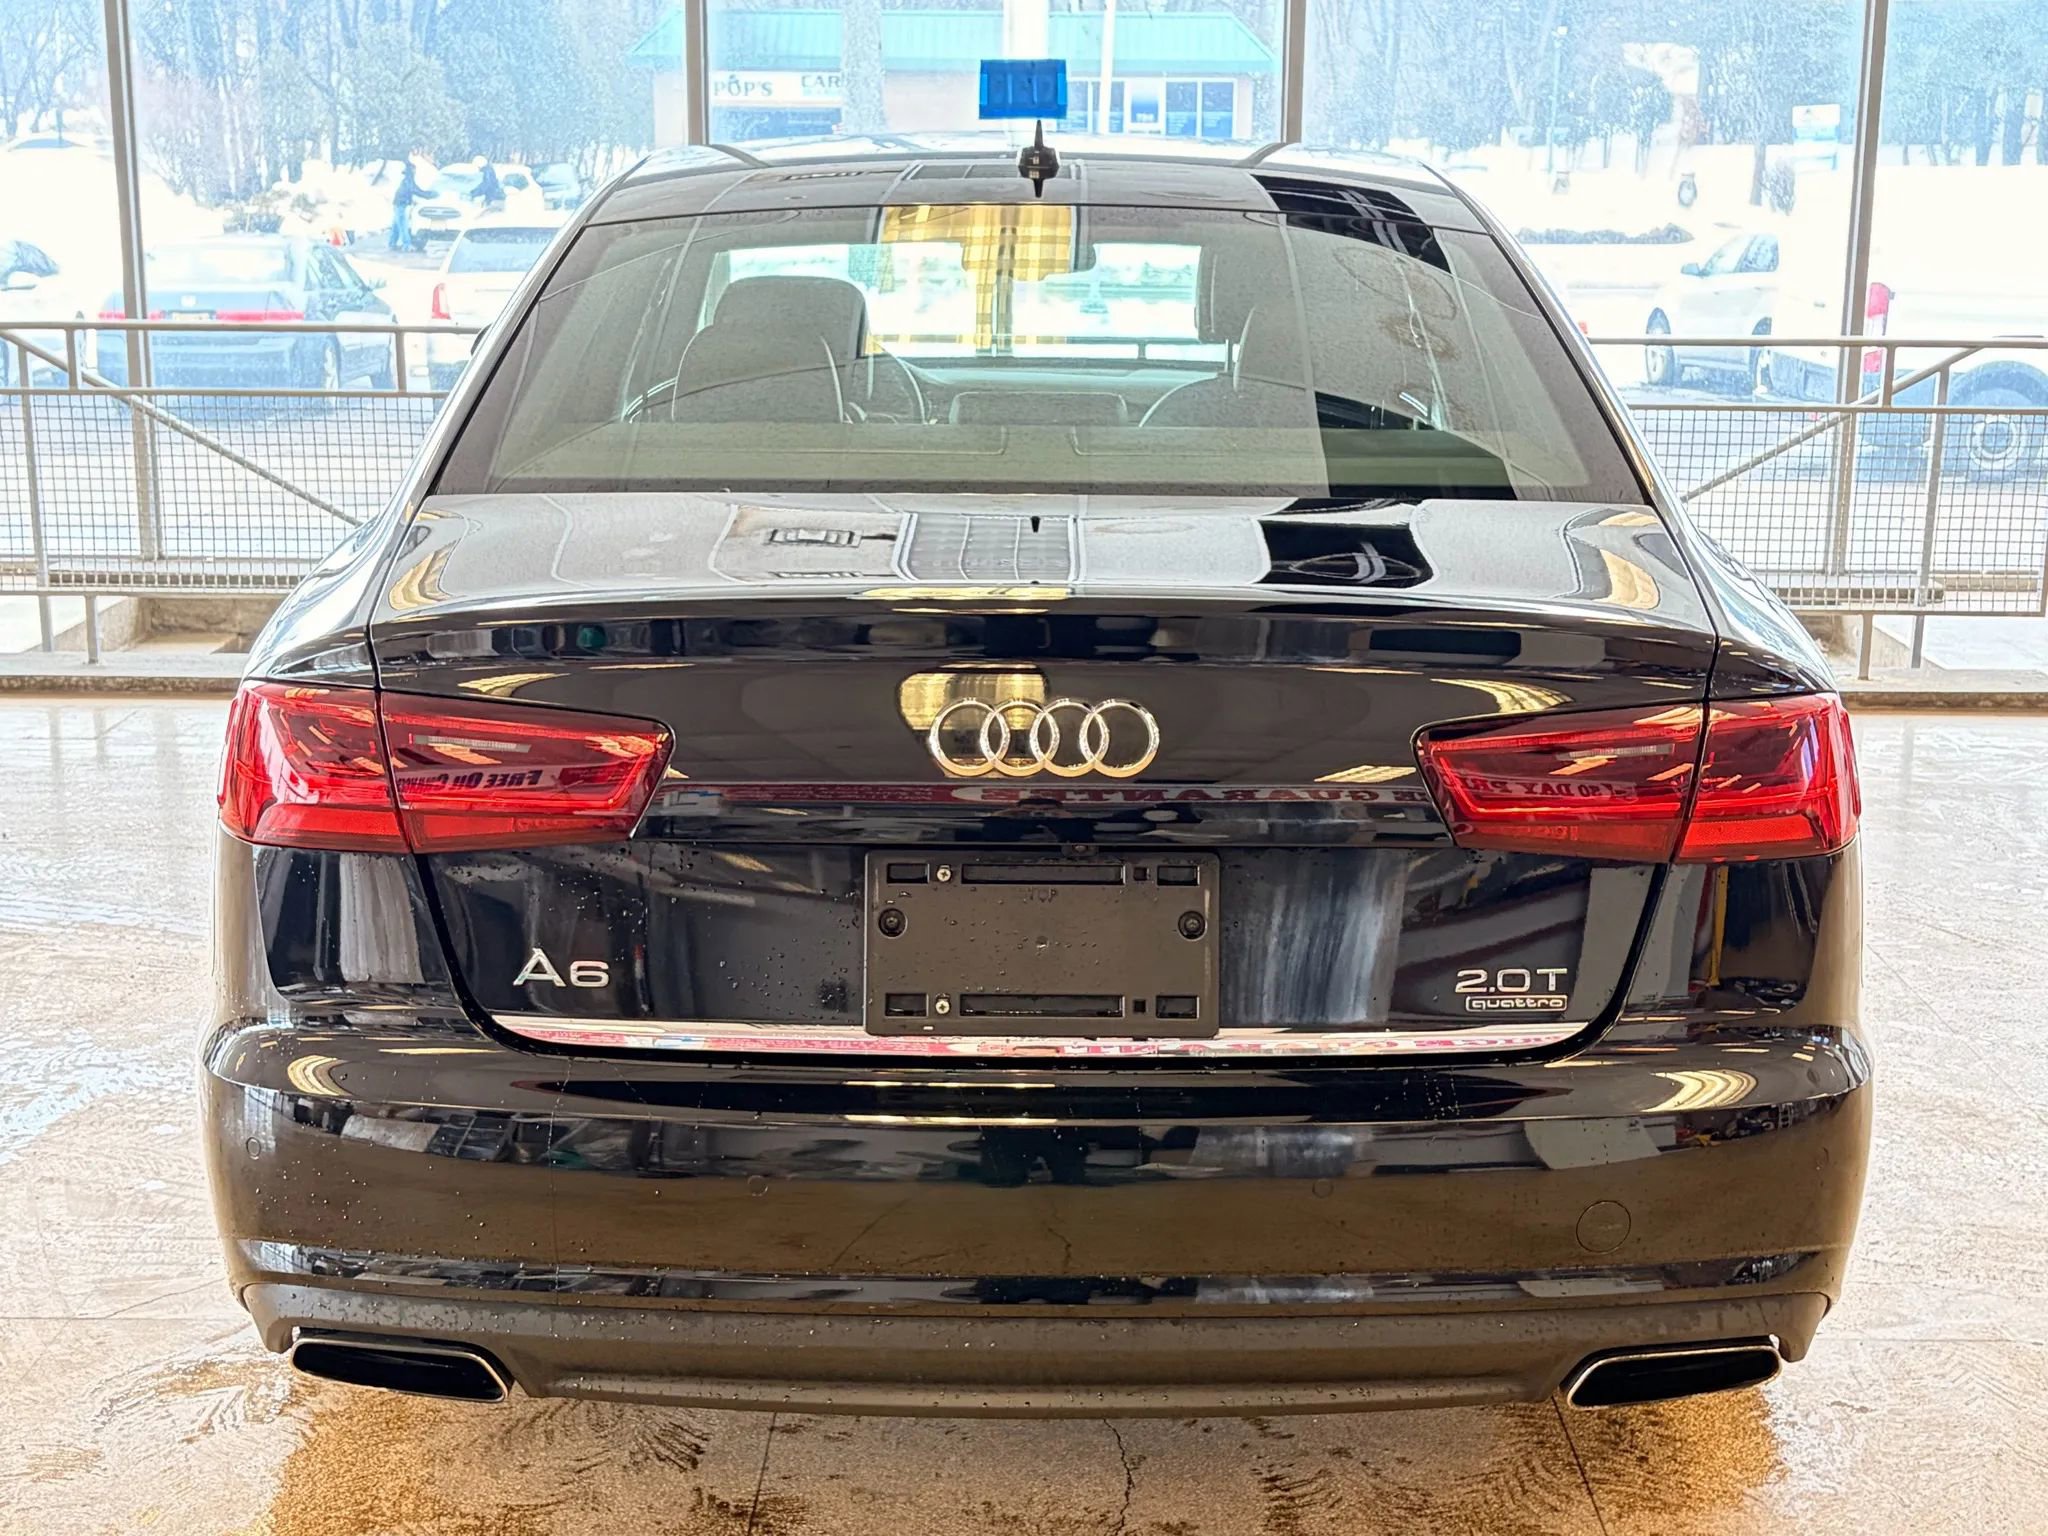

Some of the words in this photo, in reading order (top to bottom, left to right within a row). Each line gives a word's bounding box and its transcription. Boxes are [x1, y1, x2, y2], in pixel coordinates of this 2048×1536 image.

[513, 947, 610, 988] A6
[1455, 968, 1568, 993] 2.0T
[1471, 998, 1563, 1011] quattro
